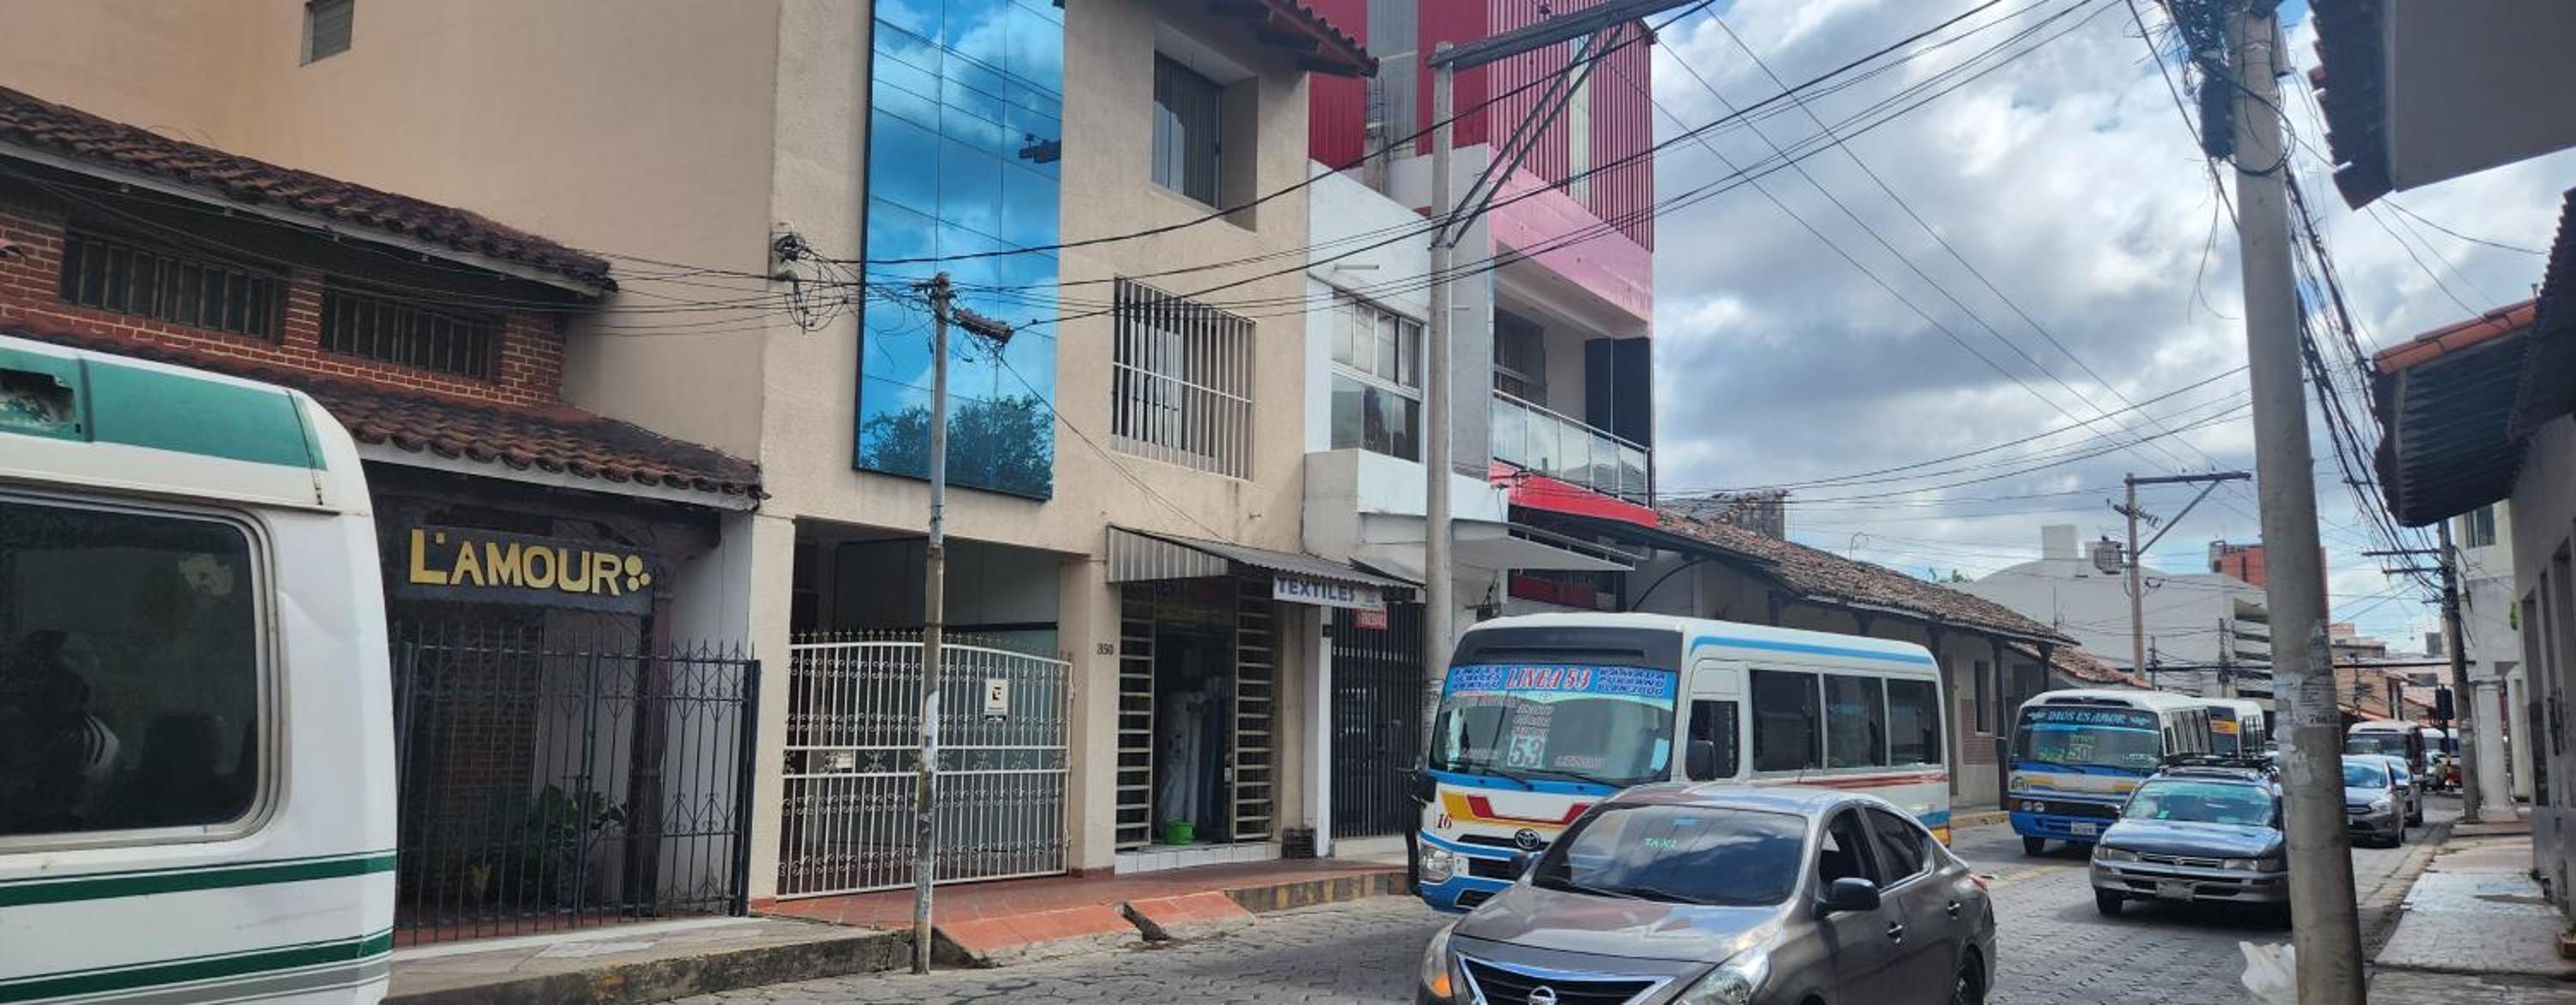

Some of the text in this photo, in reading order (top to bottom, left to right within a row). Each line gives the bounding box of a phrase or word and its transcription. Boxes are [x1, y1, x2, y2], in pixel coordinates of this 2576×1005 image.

[410, 528, 622, 596] L'AMOUR
[1277, 579, 1355, 602] TEXTILES
[1564, 667, 1592, 690] 53
[1509, 738, 1543, 765] 53
[1437, 813, 1452, 831] 16
